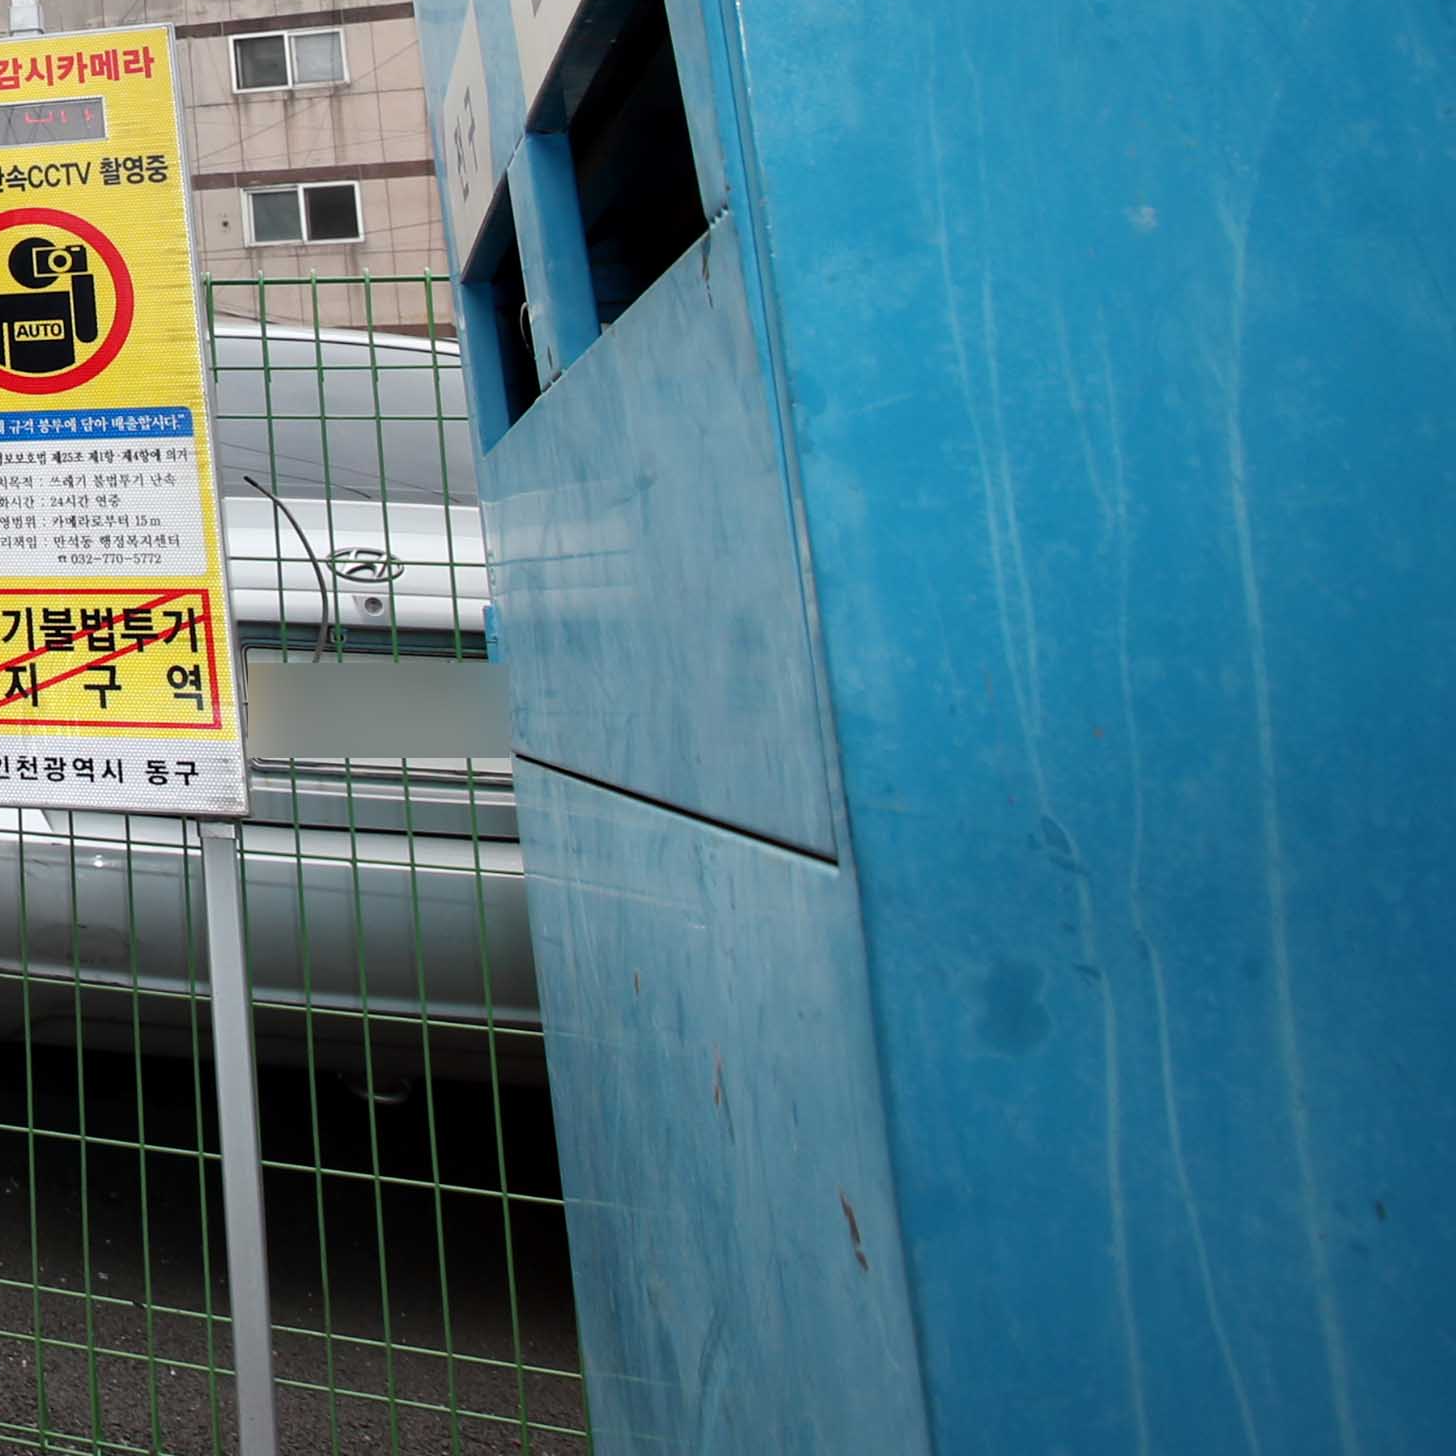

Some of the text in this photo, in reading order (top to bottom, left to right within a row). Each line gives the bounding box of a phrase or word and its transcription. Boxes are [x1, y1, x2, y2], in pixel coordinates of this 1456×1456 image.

[99, 154, 168, 186] 촬영중
[16, 323, 62, 338] AUTO
[9, 418, 34, 434] 규격
[38, 417, 77, 433] 봉투에
[82, 416, 108, 432] 담아
[52, 450, 83, 464] 제25조
[166, 447, 188, 463] 의거
[49, 474, 87, 488] 쓰레기
[93, 473, 143, 487] 불법투기
[150, 472, 176, 486] 단속
[50, 494, 88, 508] 24시간
[96, 494, 121, 507] 연중
[52, 513, 129, 528] 카메라로부터
[53, 534, 90, 549] 만석동
[100, 534, 180, 548] 행정복지센터
[71, 553, 161, 565] 032-770-5772
[145, 759, 200, 786] 동구
